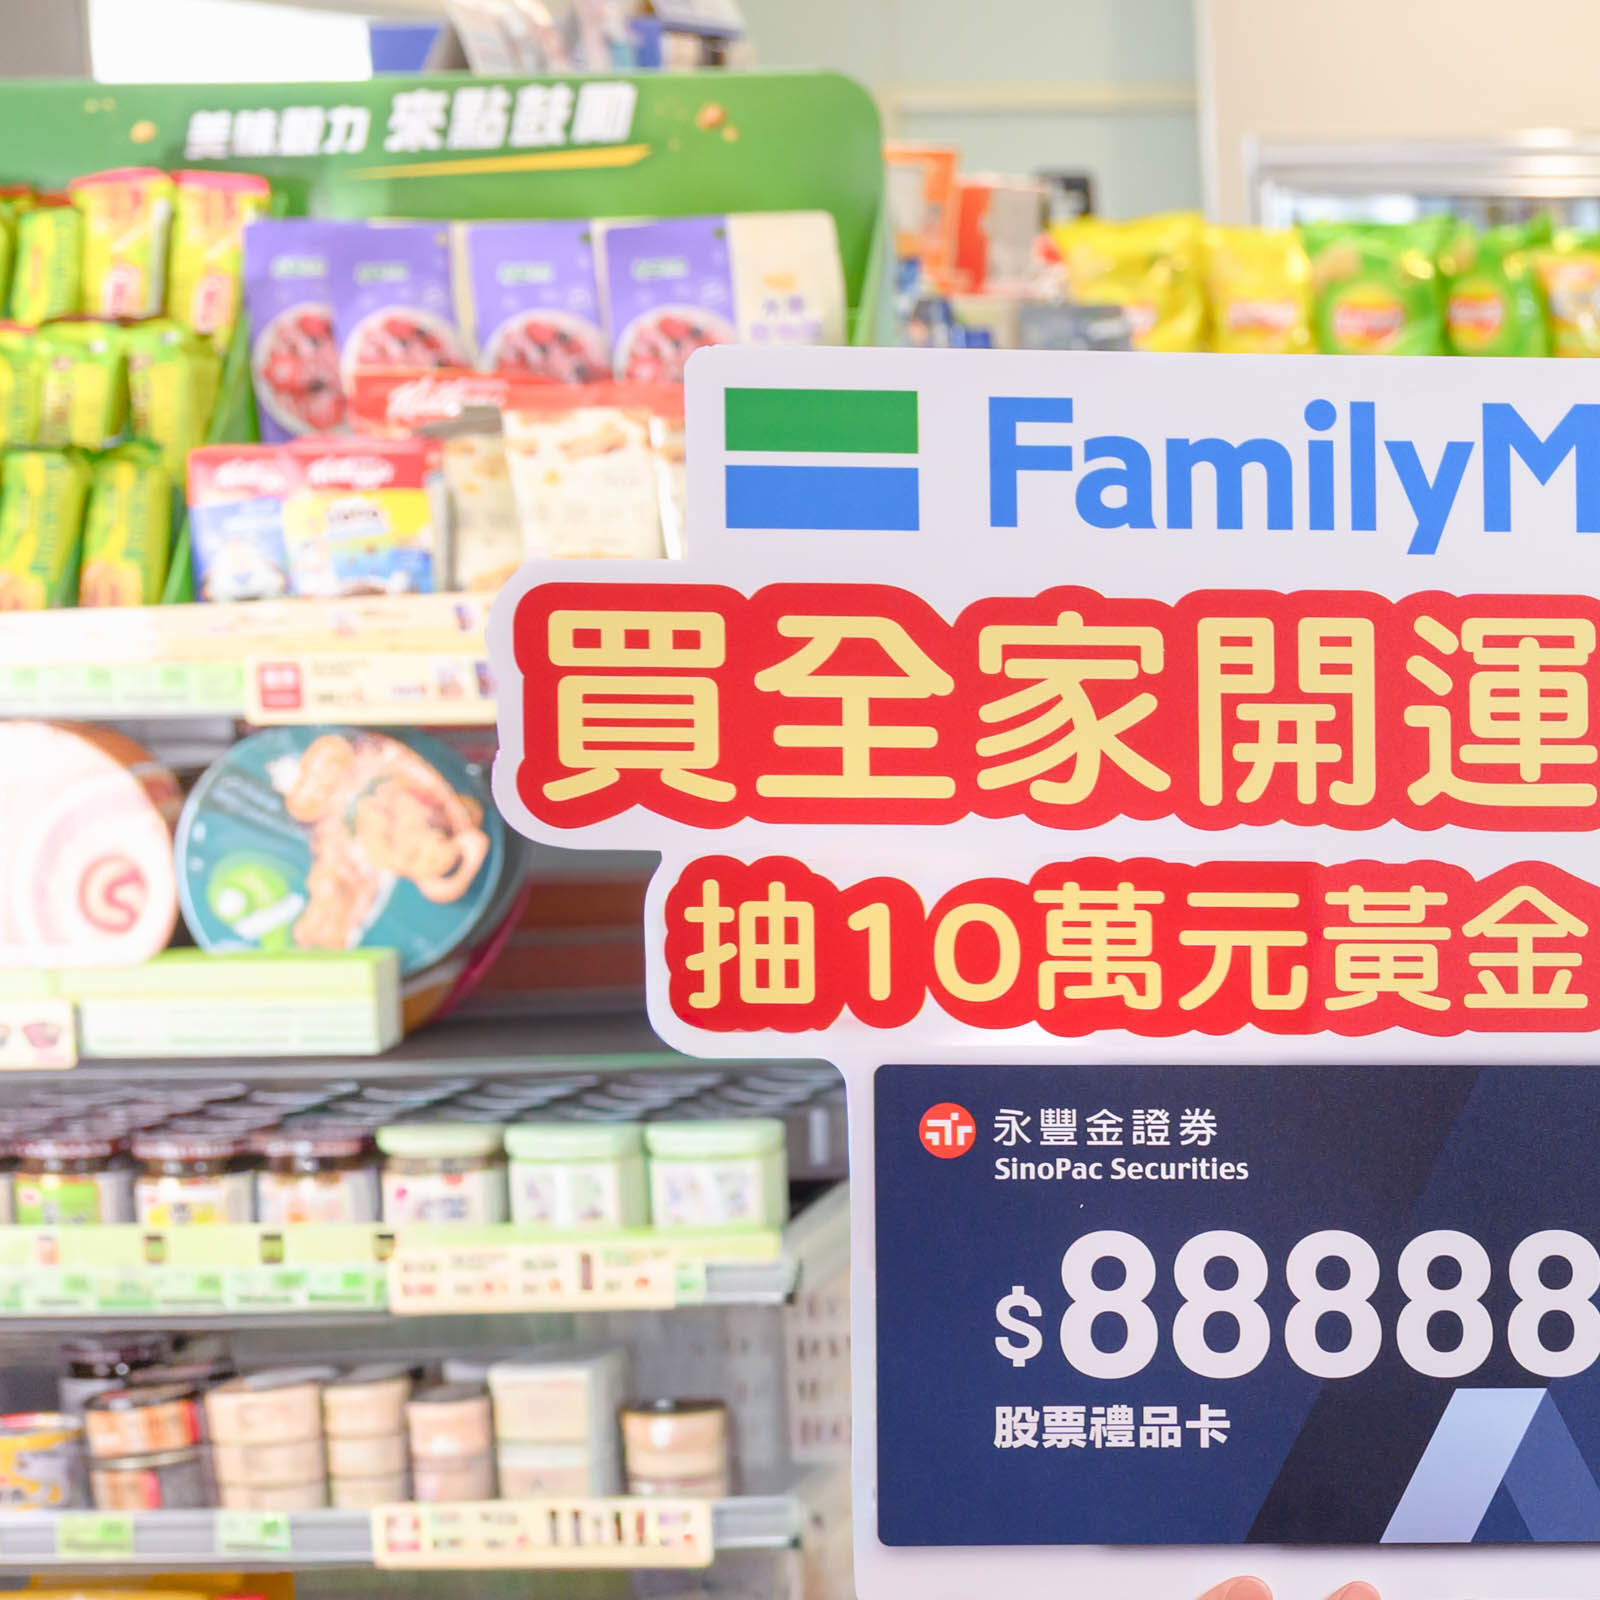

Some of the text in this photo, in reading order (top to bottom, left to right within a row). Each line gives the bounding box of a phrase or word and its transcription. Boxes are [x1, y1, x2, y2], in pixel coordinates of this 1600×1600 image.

[992, 1107, 1218, 1148] 永豐金證券
[994, 1156, 1250, 1182] SinoPac Securities
[993, 1404, 1231, 1449] 股票禮品卡
